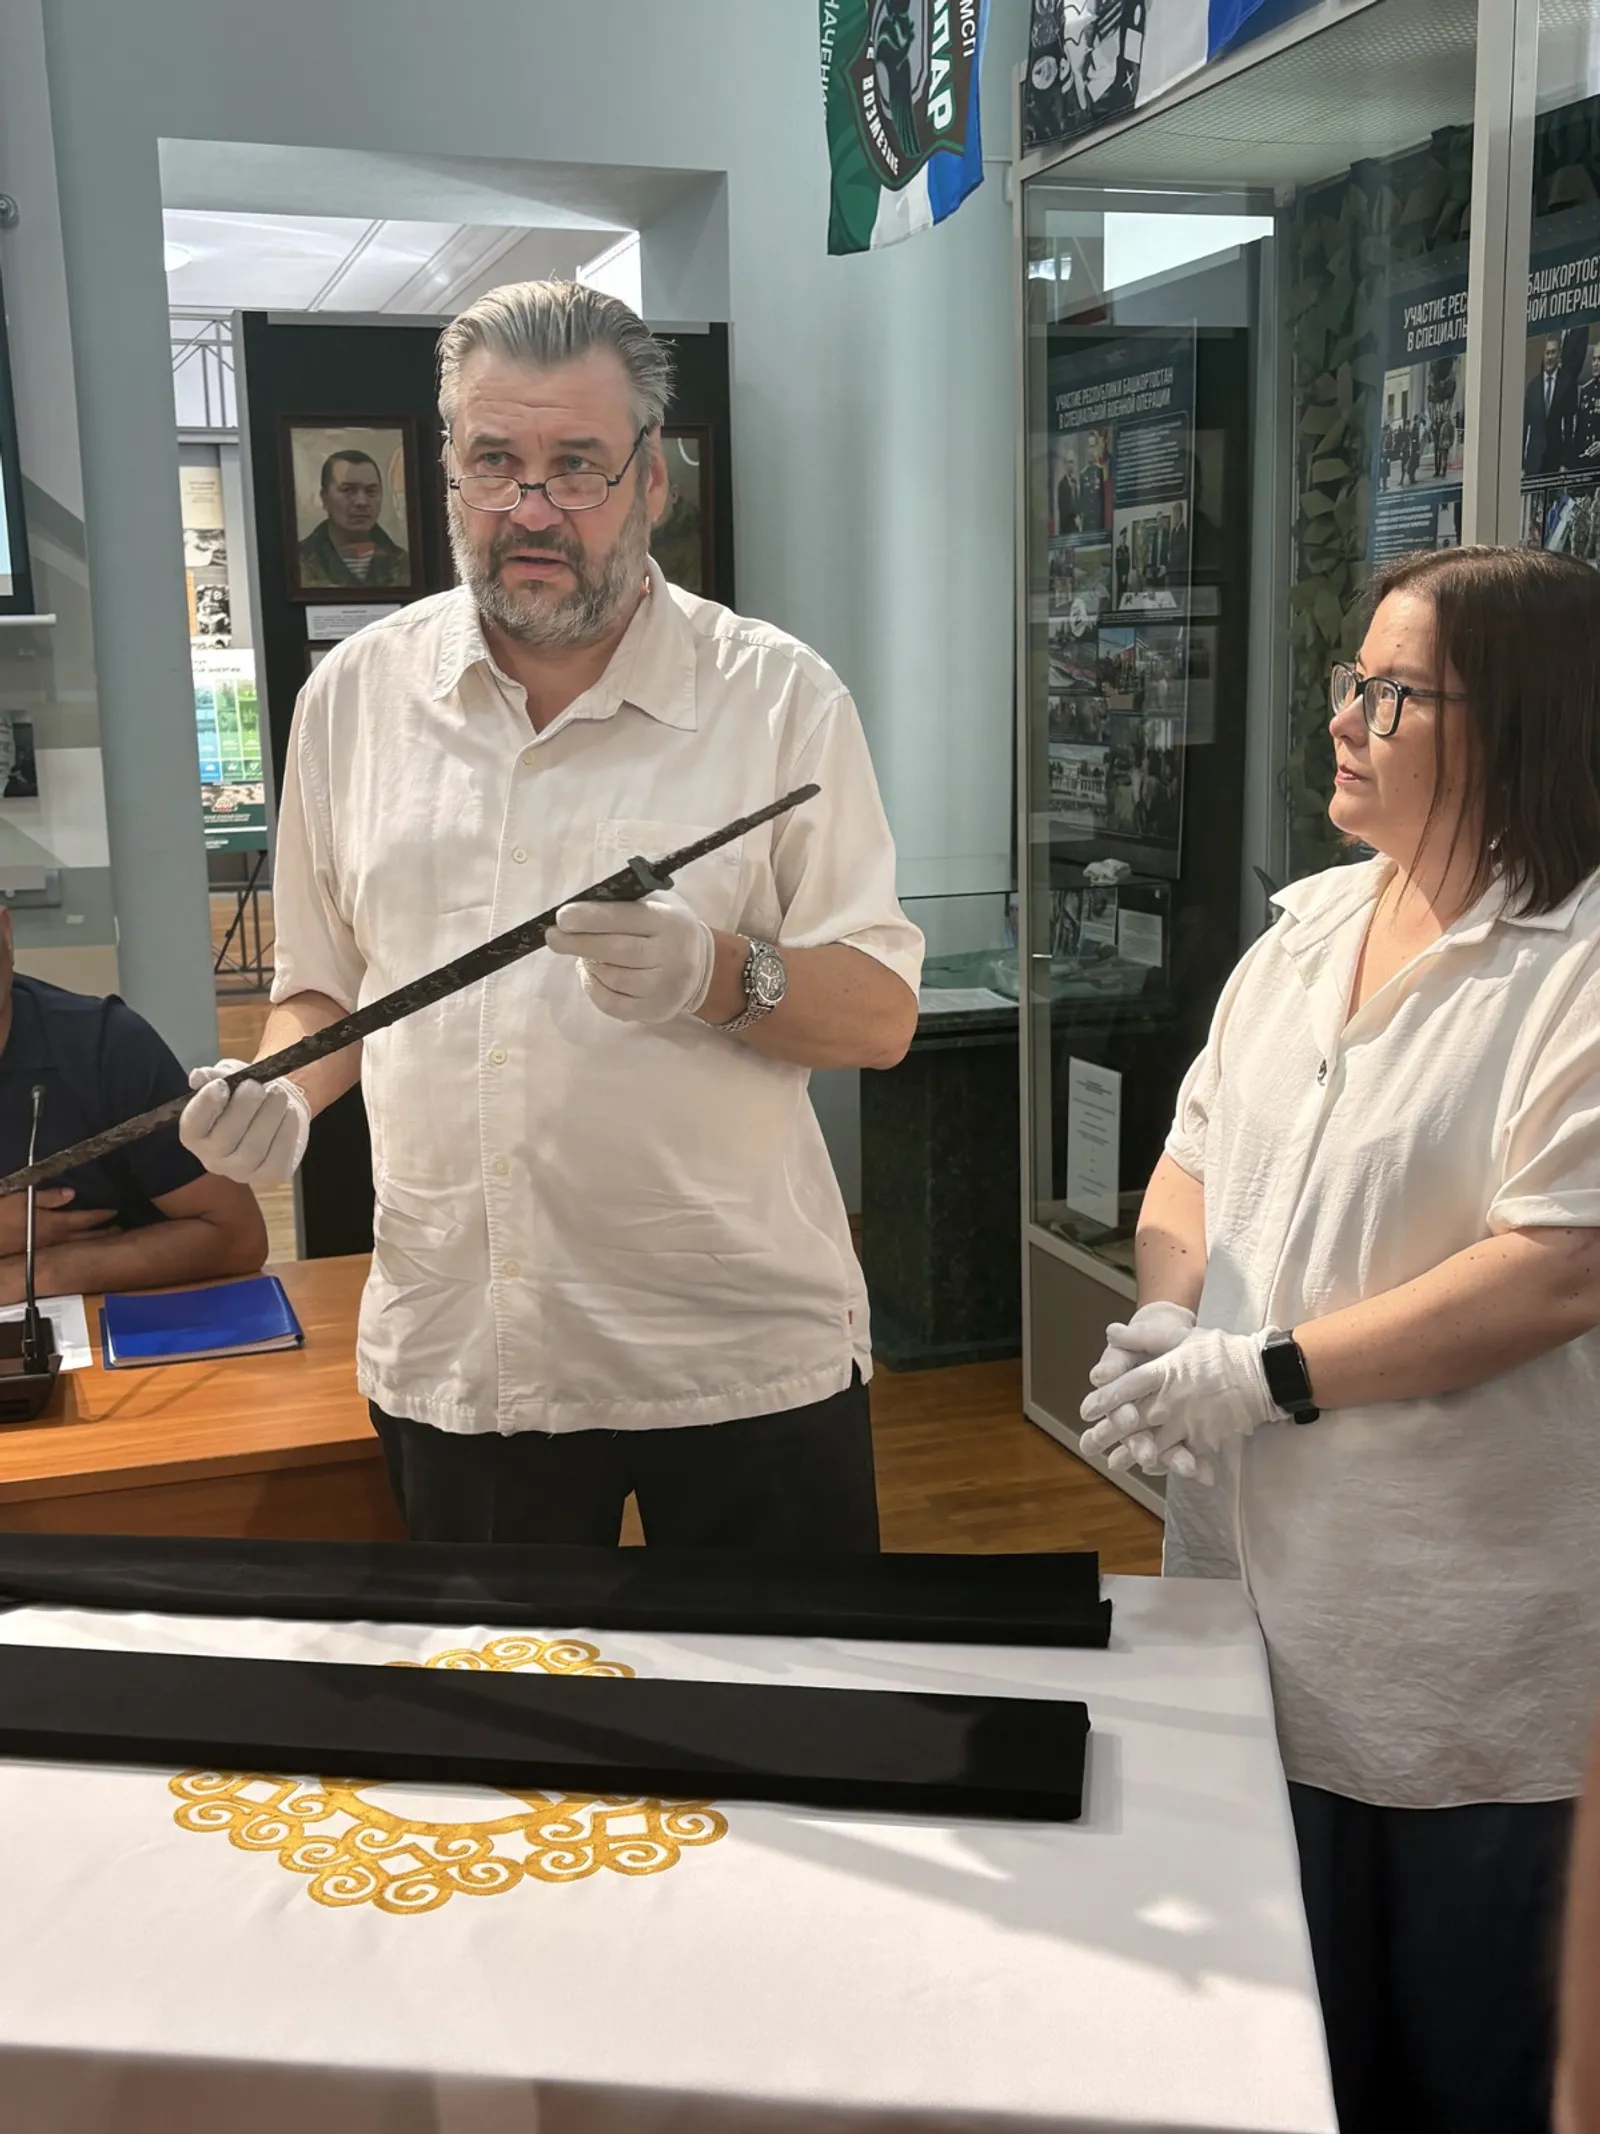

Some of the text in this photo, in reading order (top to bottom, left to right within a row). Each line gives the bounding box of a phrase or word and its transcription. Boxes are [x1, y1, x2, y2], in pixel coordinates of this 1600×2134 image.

[1403, 255, 1600, 329] УЧАСТИЕ РЕС БАШКОРТОС
[1407, 331, 1415, 352] В
[1415, 317, 1468, 350] СПЕЦИАЛЬ
[1526, 293, 1548, 323] НОЙ
